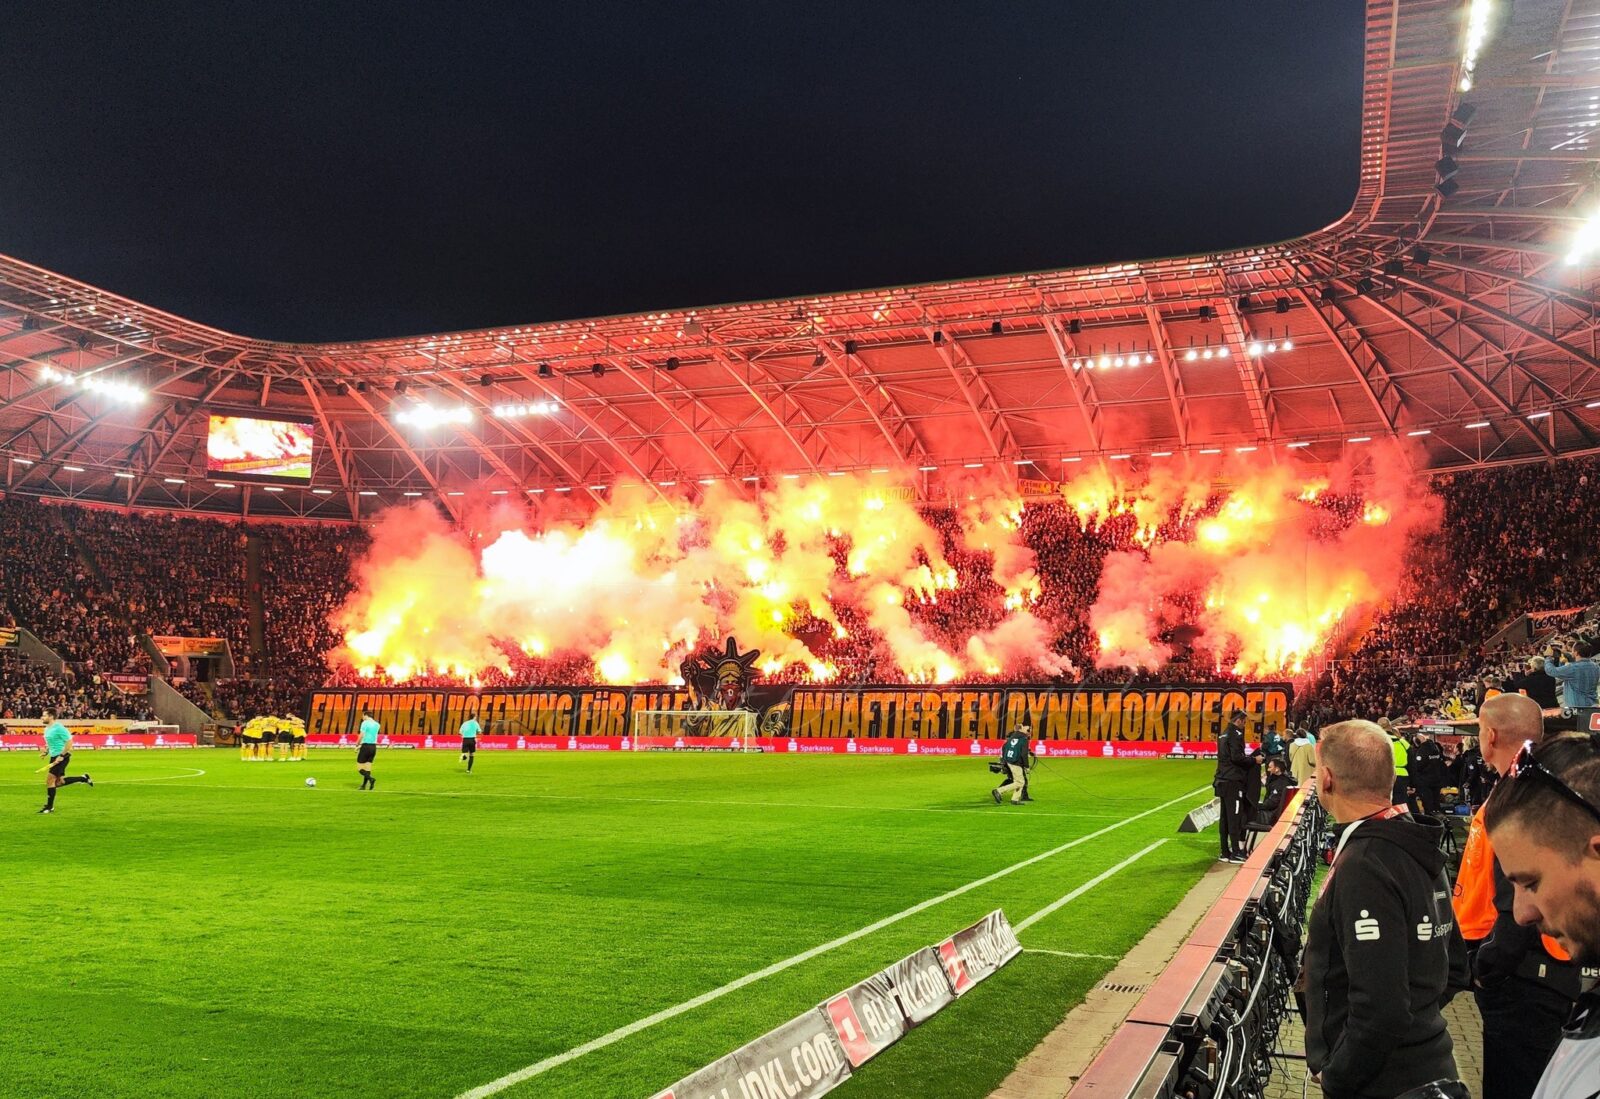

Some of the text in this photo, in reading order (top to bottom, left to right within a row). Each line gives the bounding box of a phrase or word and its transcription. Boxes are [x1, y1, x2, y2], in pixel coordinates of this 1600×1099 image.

[308, 693, 353, 735] EIN
[628, 693, 690, 737] ALLE
[791, 692, 1000, 739] INHAFTIERTEN
[800, 744, 834, 752] Sparkasse
[859, 745, 894, 753] Sparkasse
[920, 746, 957, 754] Sparkasse
[1049, 747, 1088, 757] Sparkasse
[1116, 748, 1157, 757] Sparkasse
